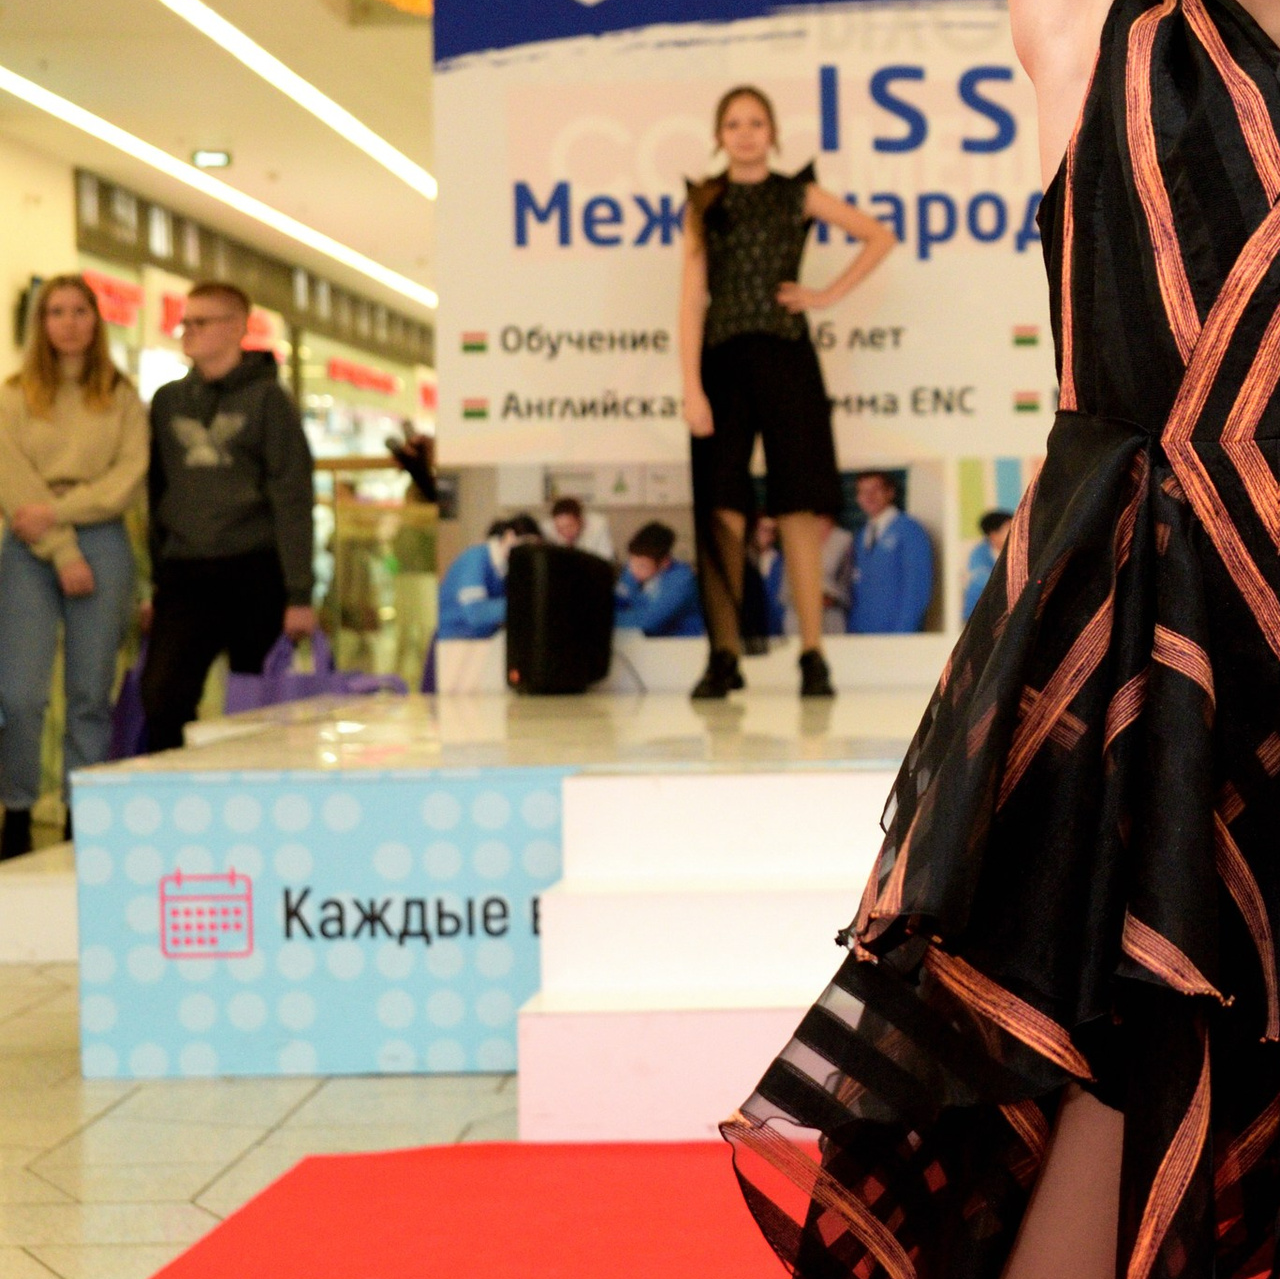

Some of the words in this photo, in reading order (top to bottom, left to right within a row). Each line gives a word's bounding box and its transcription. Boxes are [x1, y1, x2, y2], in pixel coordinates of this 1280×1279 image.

[500, 323, 669, 360] Обучение
[848, 325, 903, 351] лет
[500, 390, 684, 419] Английска
[910, 385, 975, 415] ENC
[284, 885, 510, 946] Каждые
